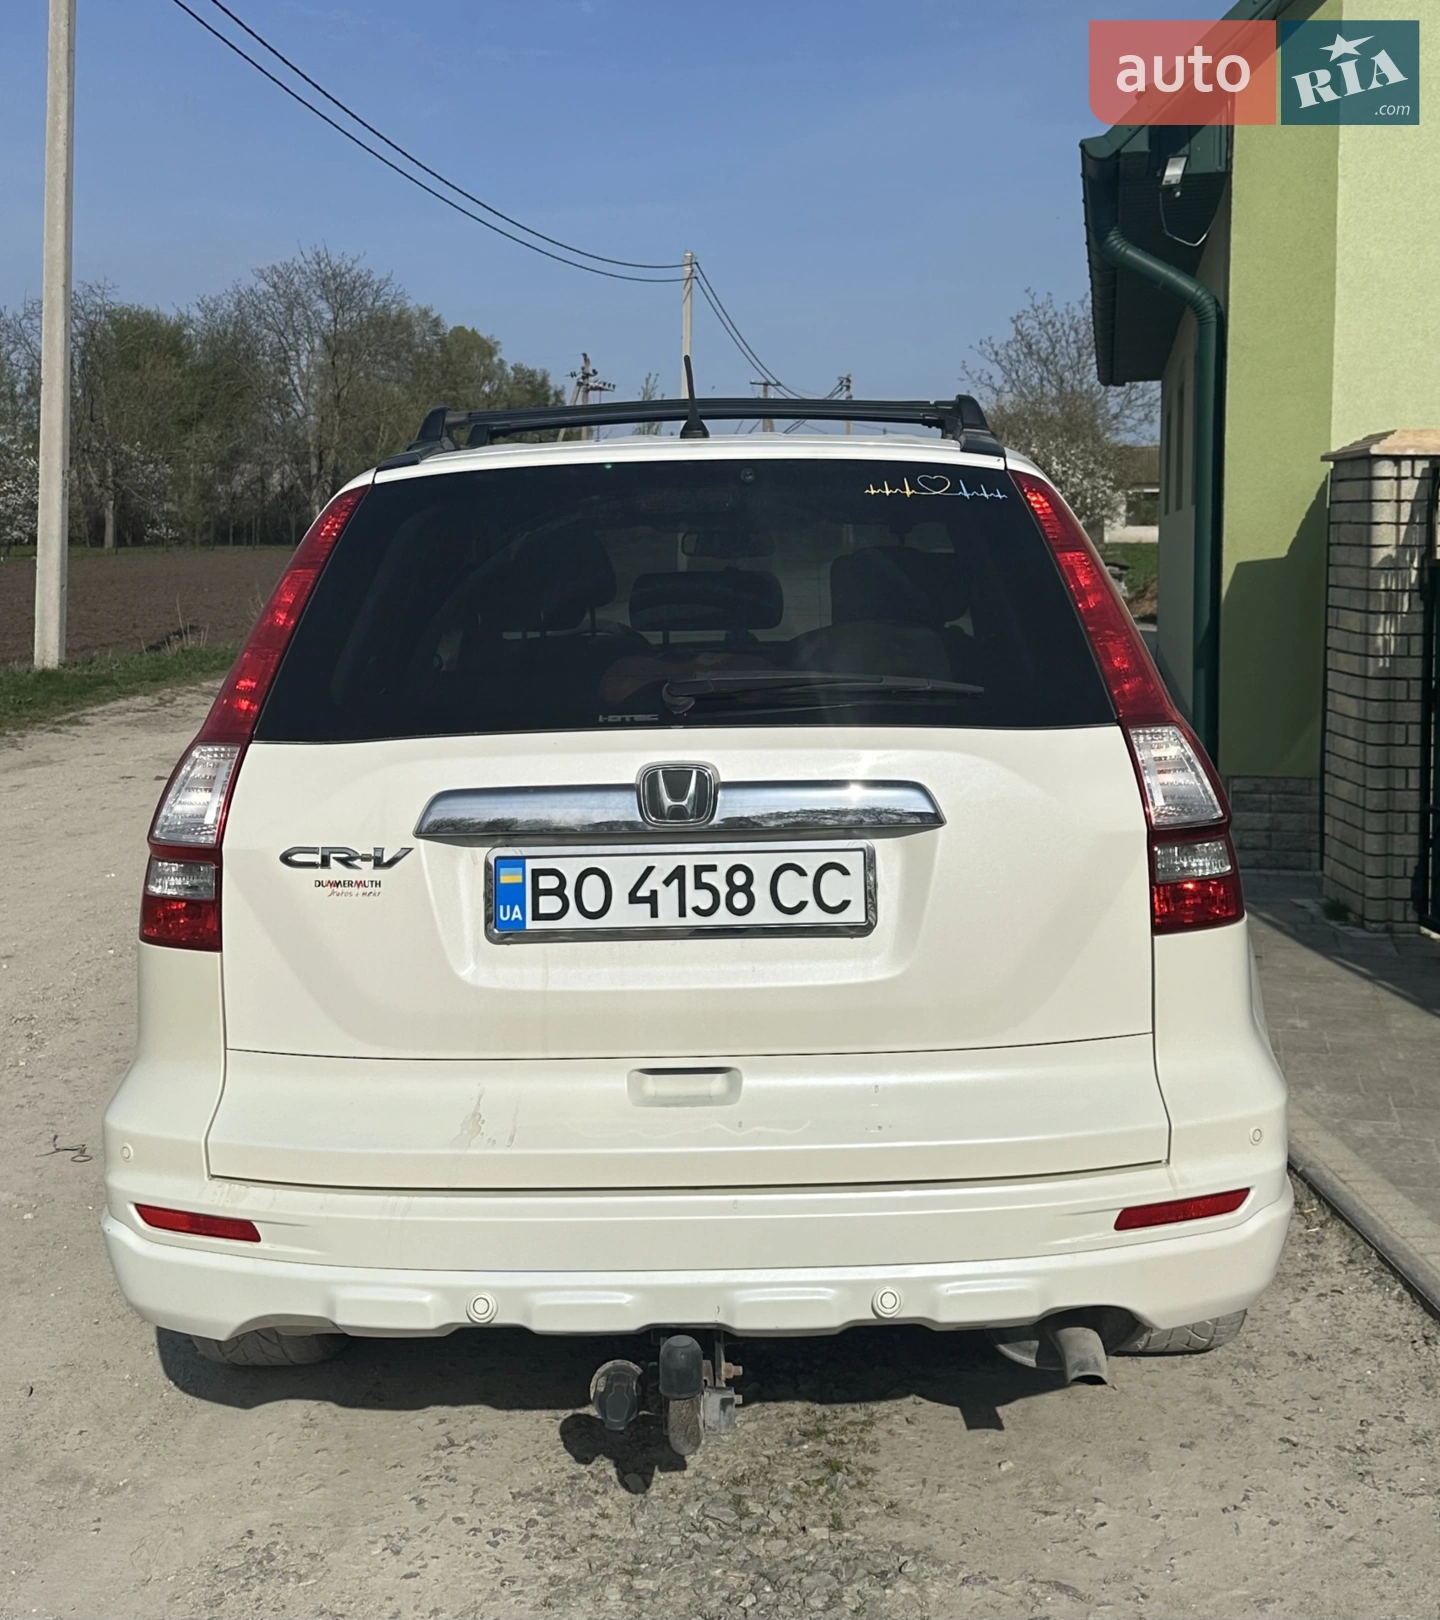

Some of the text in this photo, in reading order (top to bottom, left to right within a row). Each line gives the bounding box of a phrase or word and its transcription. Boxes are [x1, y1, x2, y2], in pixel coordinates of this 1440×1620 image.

[279, 846, 414, 870] CR-V
[531, 862, 852, 922] BO 4158 CC
[499, 904, 523, 921] UA
